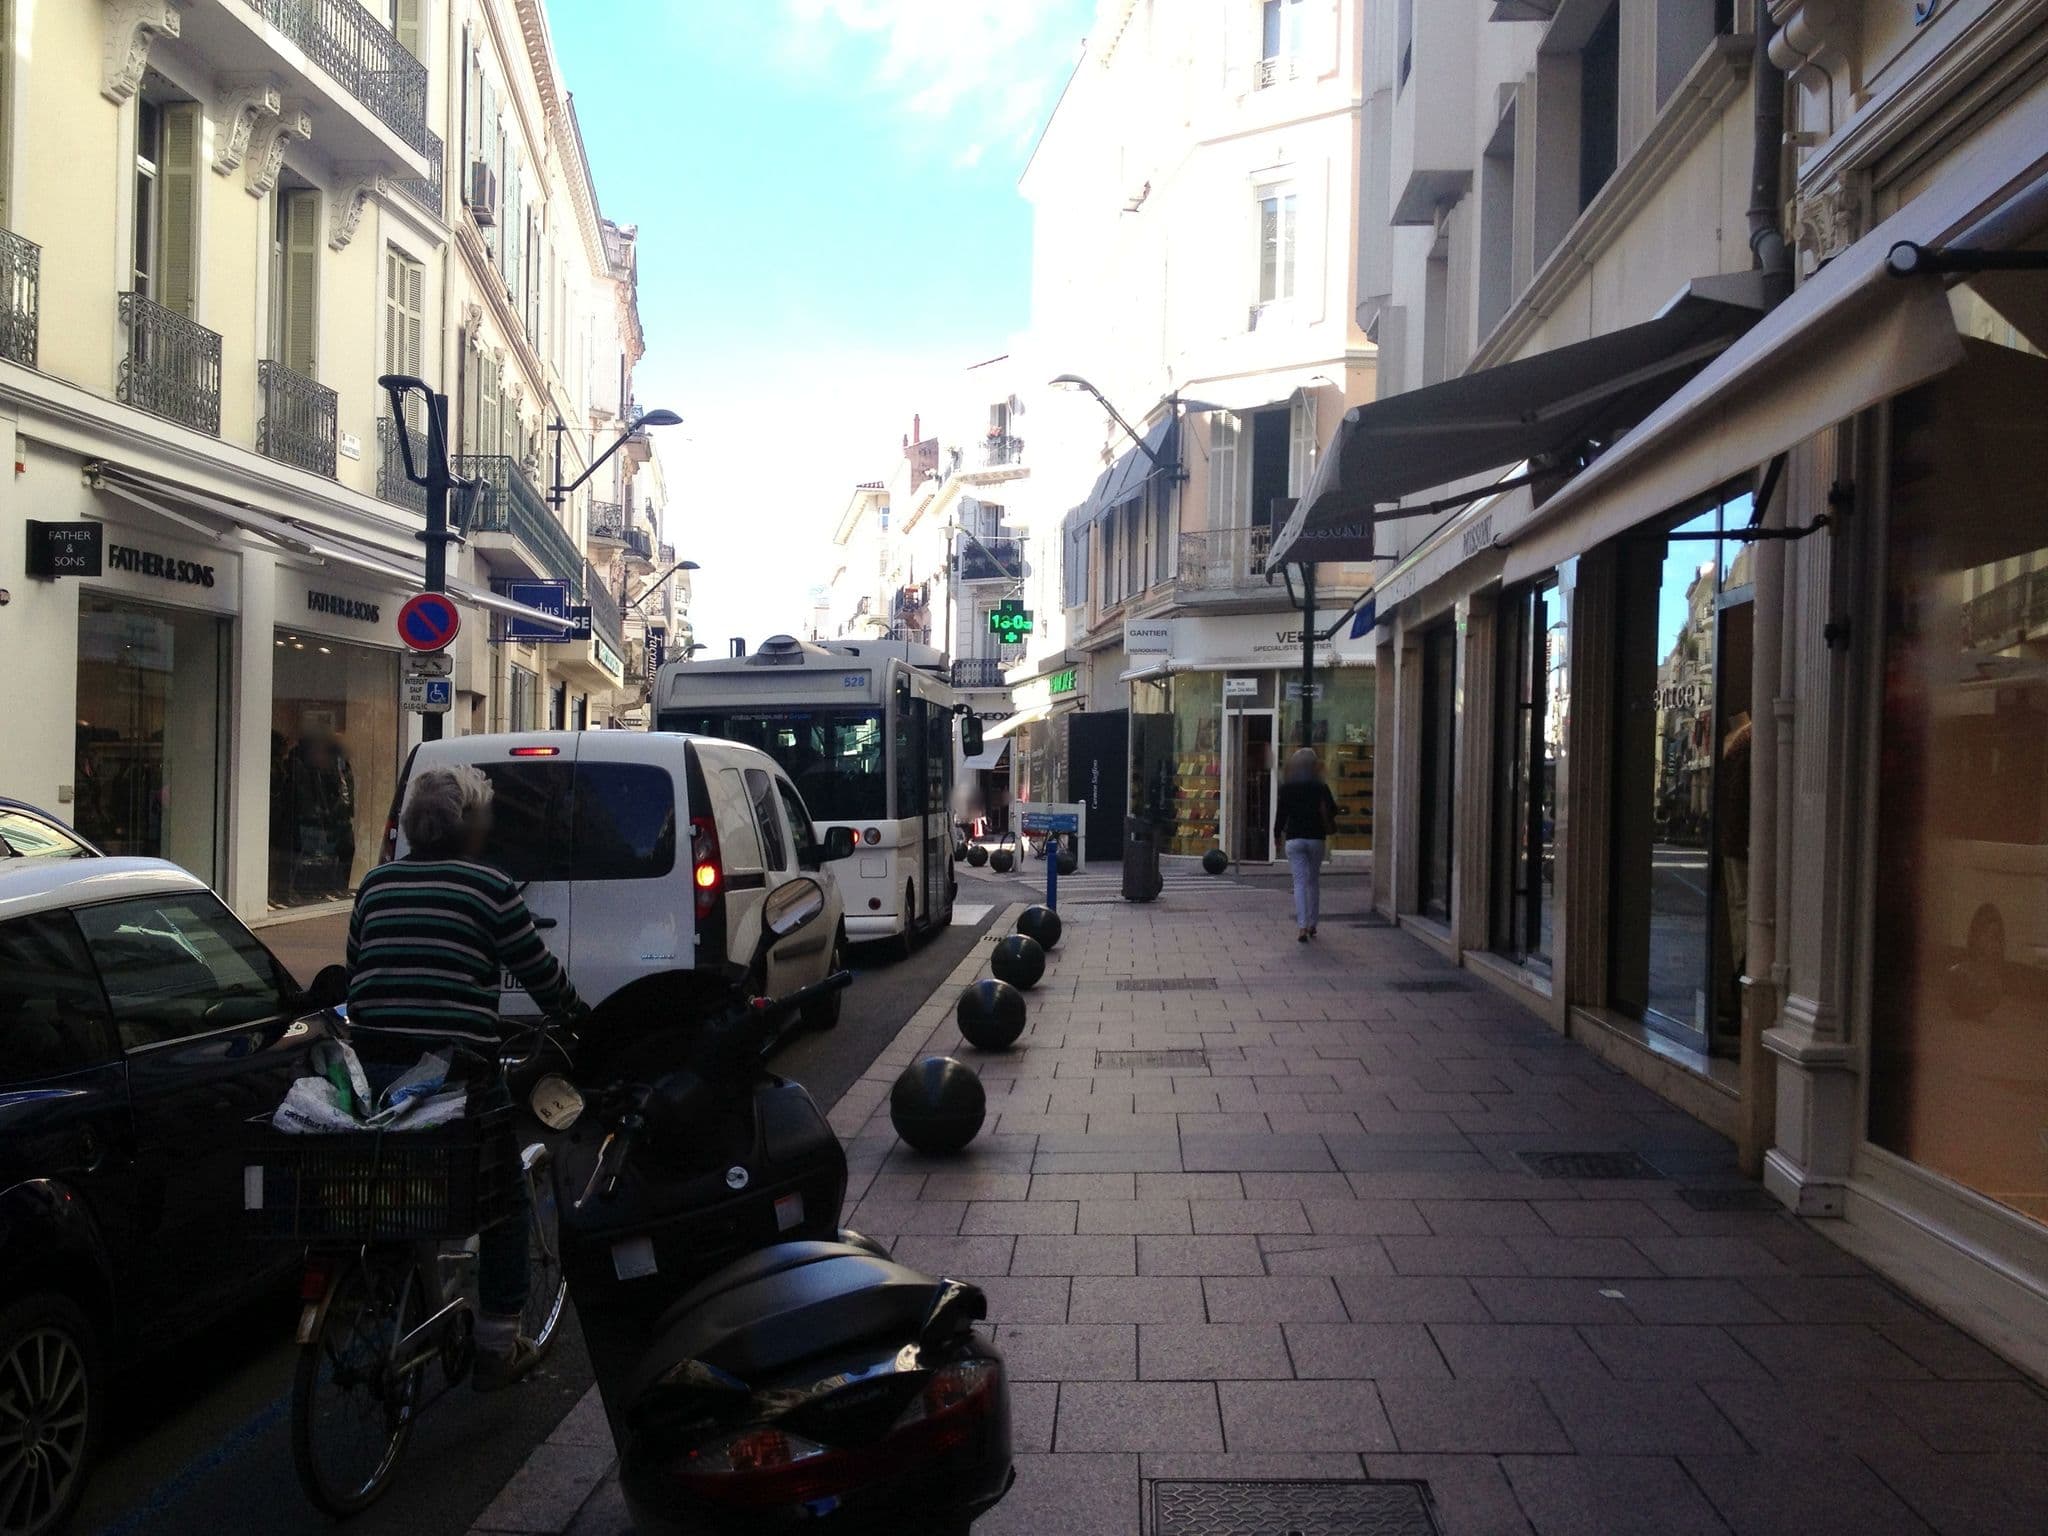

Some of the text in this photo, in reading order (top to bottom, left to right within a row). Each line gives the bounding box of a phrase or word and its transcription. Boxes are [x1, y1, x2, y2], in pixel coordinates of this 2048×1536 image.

[48, 530, 92, 541] FATHER
[65, 543, 74, 553] &
[54, 556, 86, 567] SONS
[844, 676, 865, 688] 528
